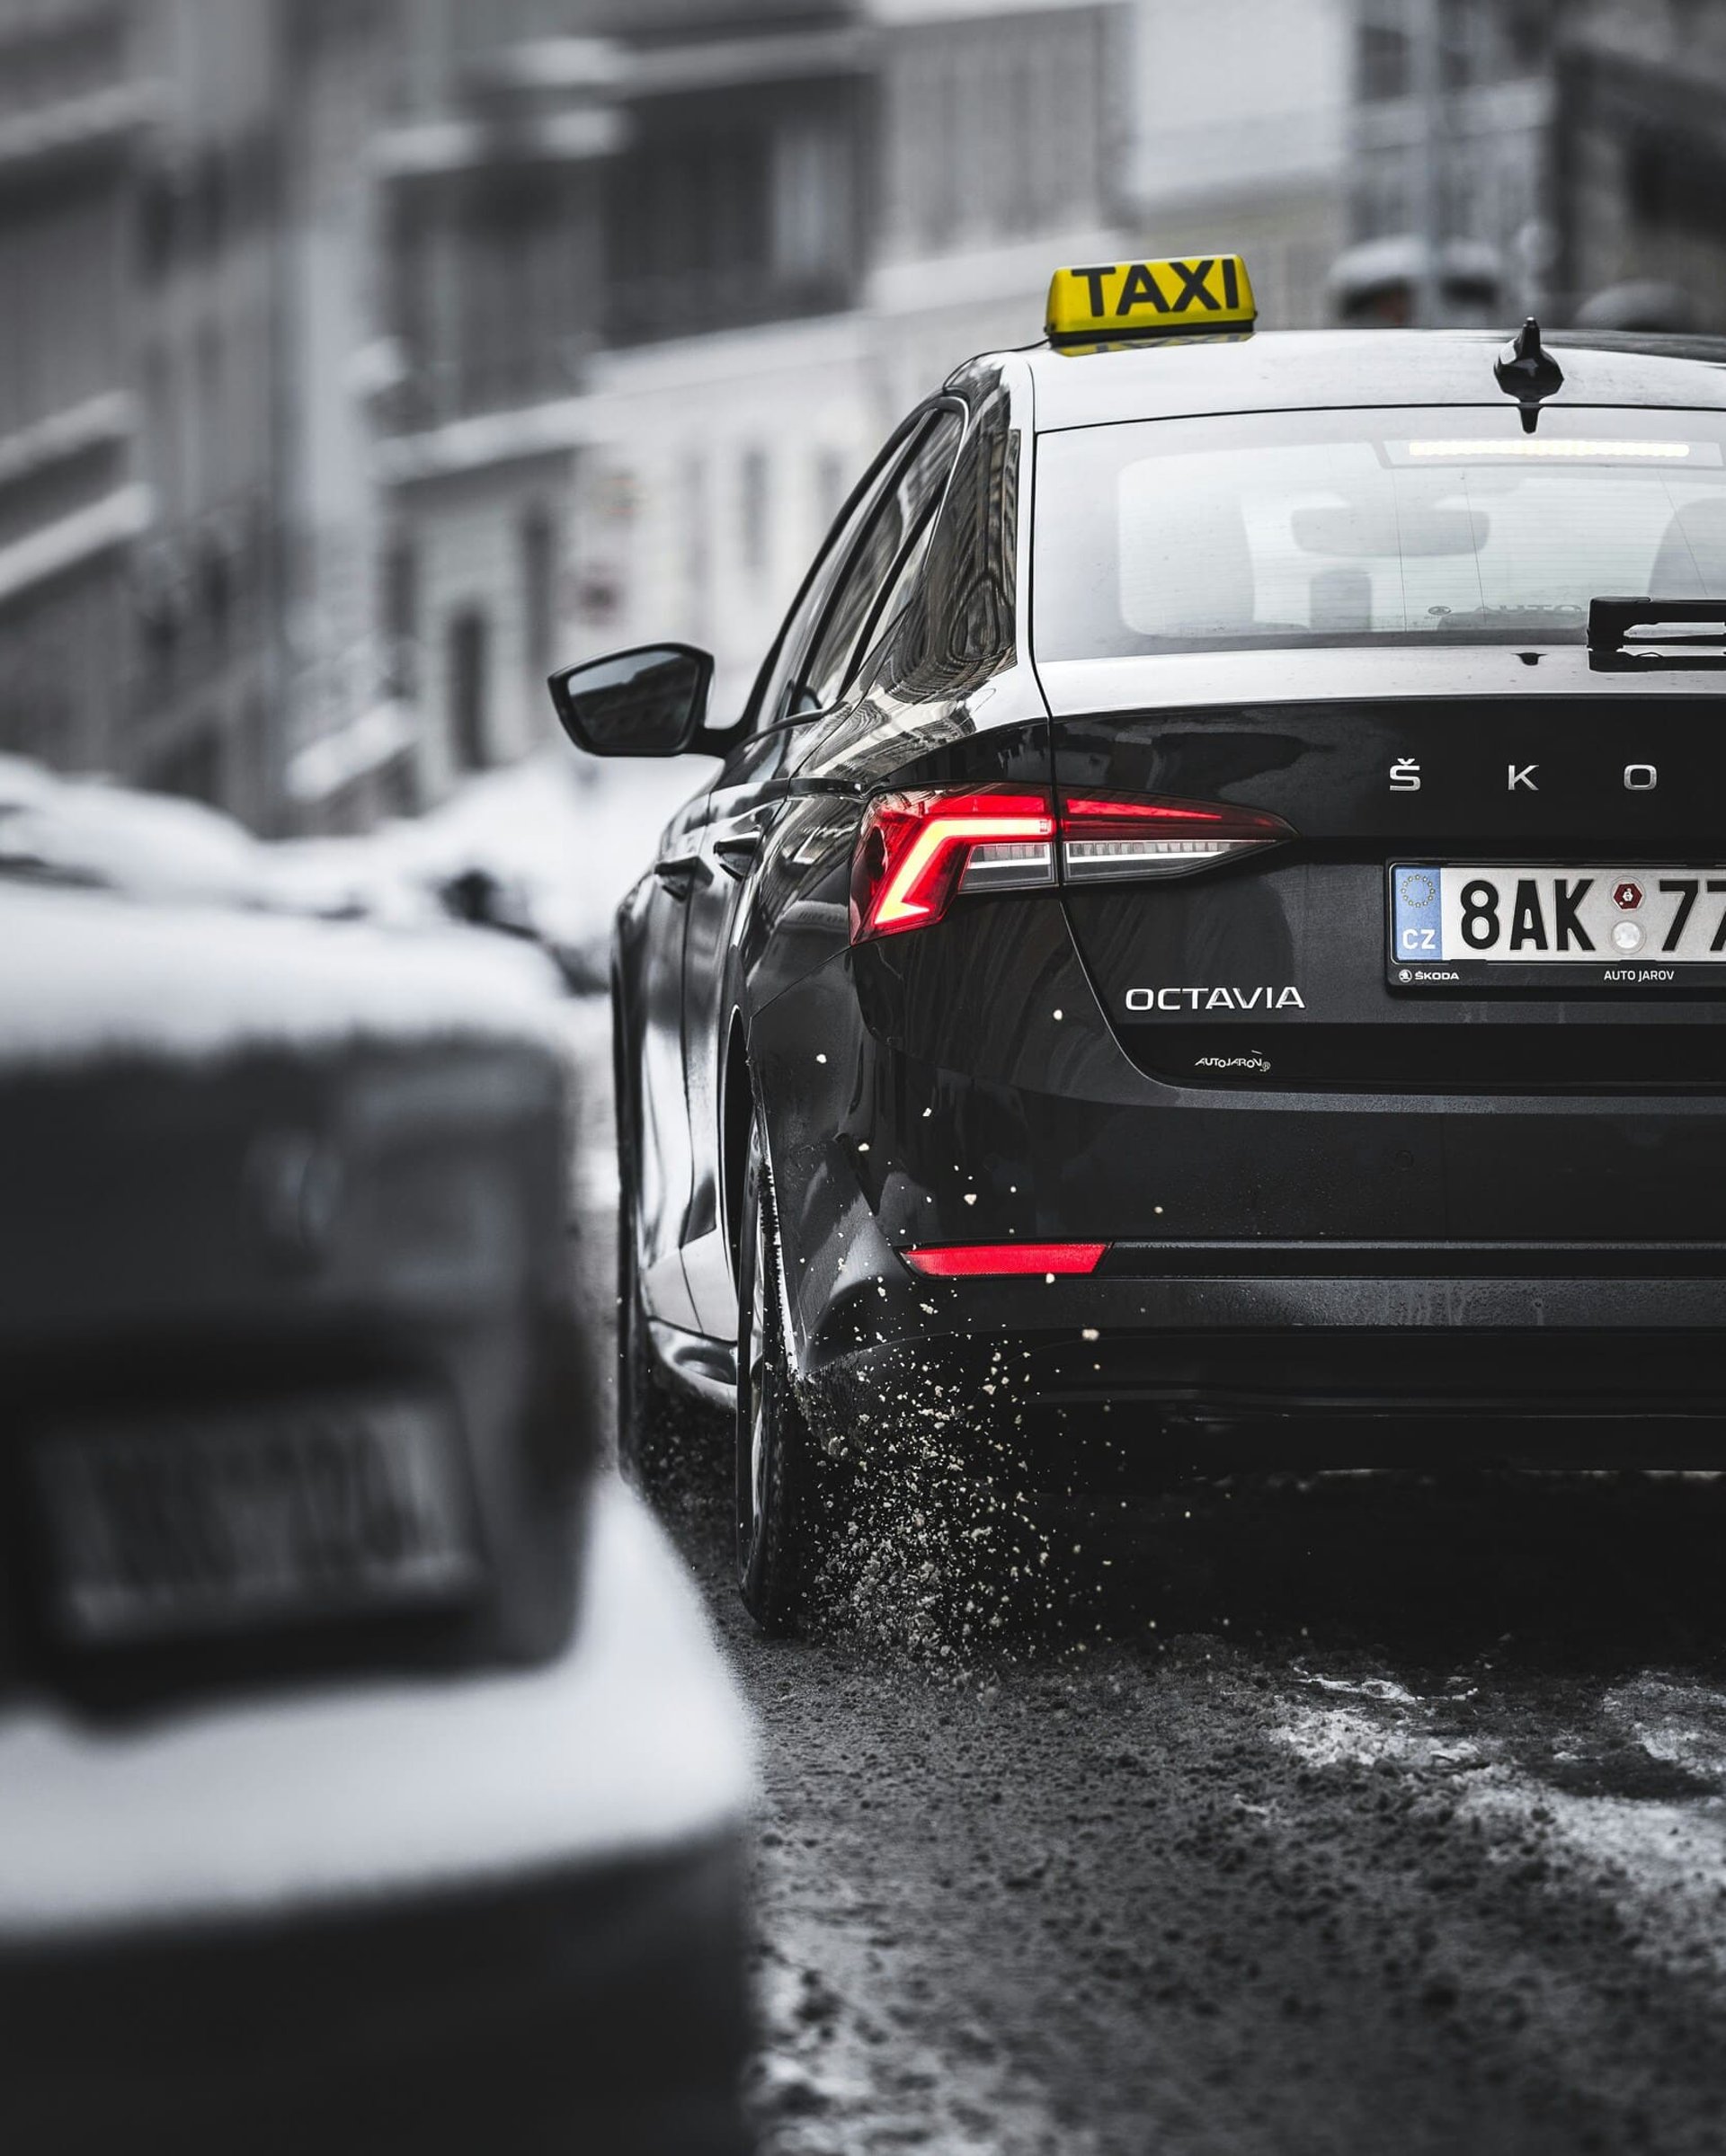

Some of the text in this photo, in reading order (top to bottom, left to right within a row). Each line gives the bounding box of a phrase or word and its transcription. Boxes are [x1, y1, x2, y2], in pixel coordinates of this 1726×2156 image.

[1071, 258, 1240, 317] TAXI
[1460, 879, 1597, 952] 8AK
[1401, 928, 1437, 950] CZ
[1414, 971, 1460, 980] ŠKODA
[1604, 970, 1675, 982] AUTO JAROV
[1125, 987, 1306, 1011] OCTAVIA
